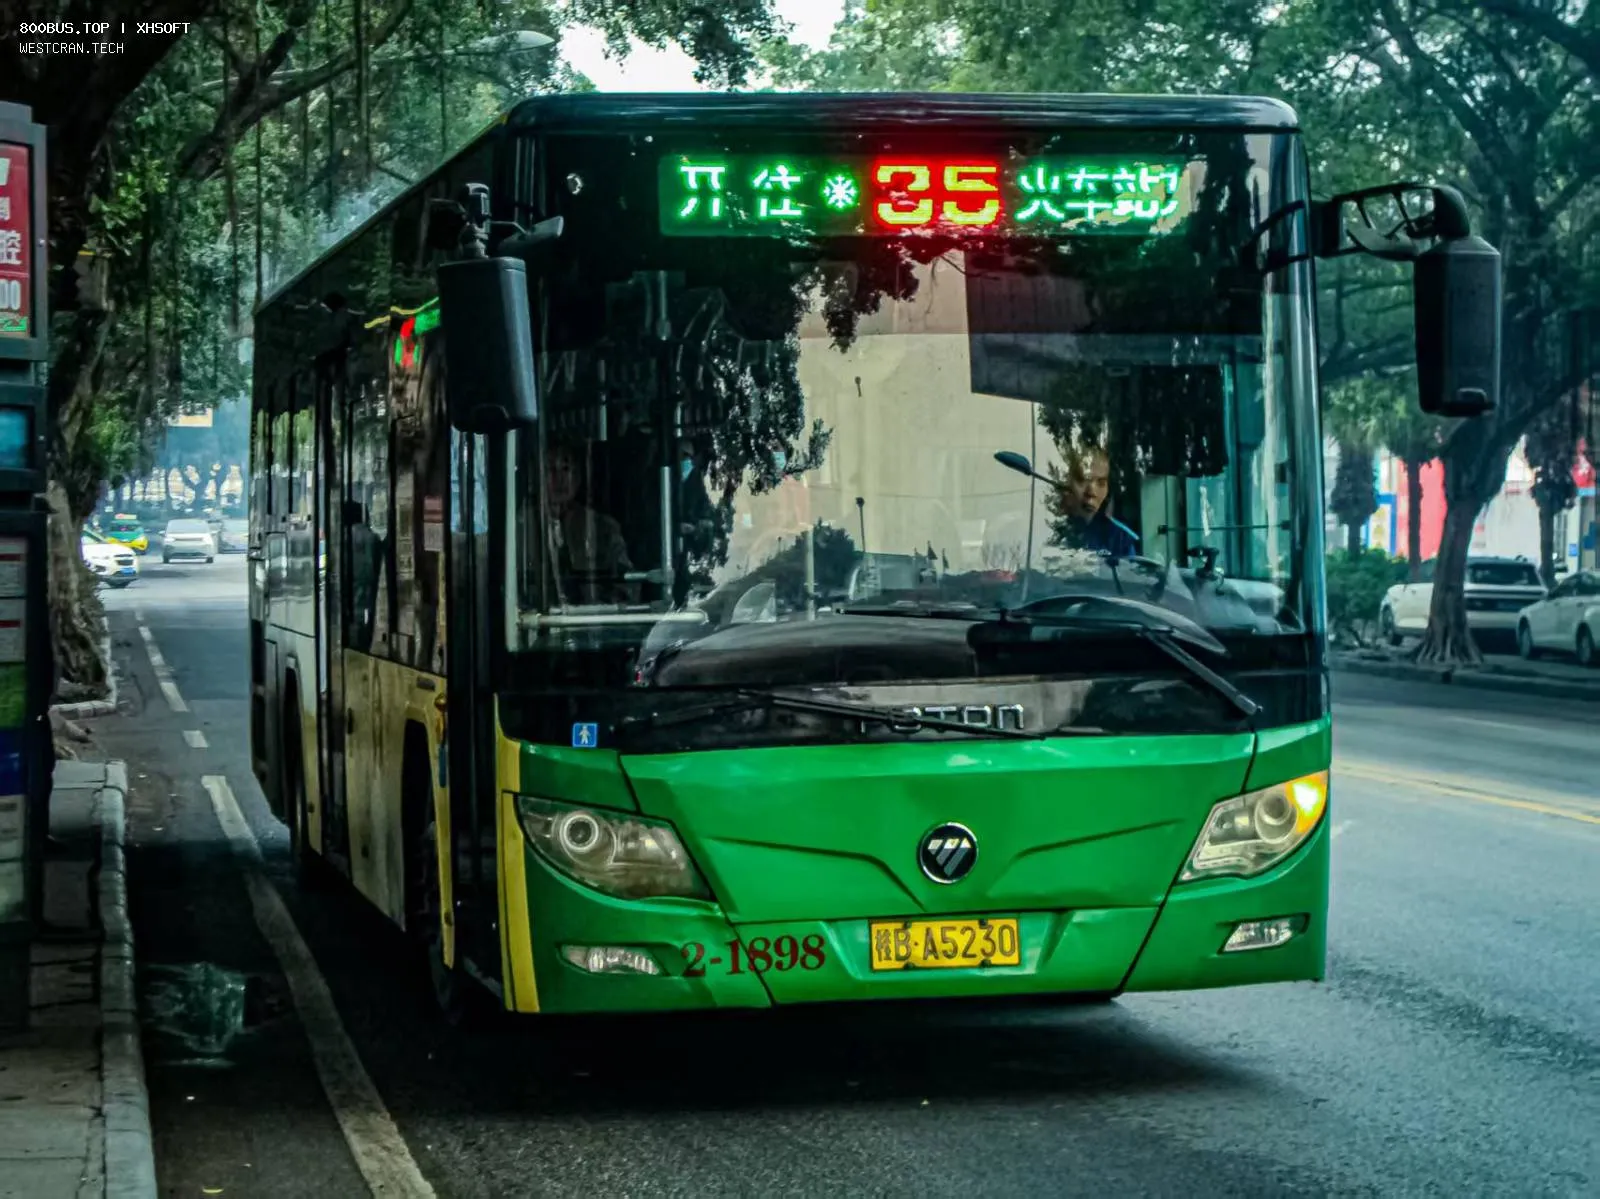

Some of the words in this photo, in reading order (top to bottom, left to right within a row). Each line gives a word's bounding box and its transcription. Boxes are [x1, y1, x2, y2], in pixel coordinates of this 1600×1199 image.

[876, 165, 1000, 225] 35
[861, 703, 1024, 734] OTON
[681, 934, 826, 977] 2-1898
